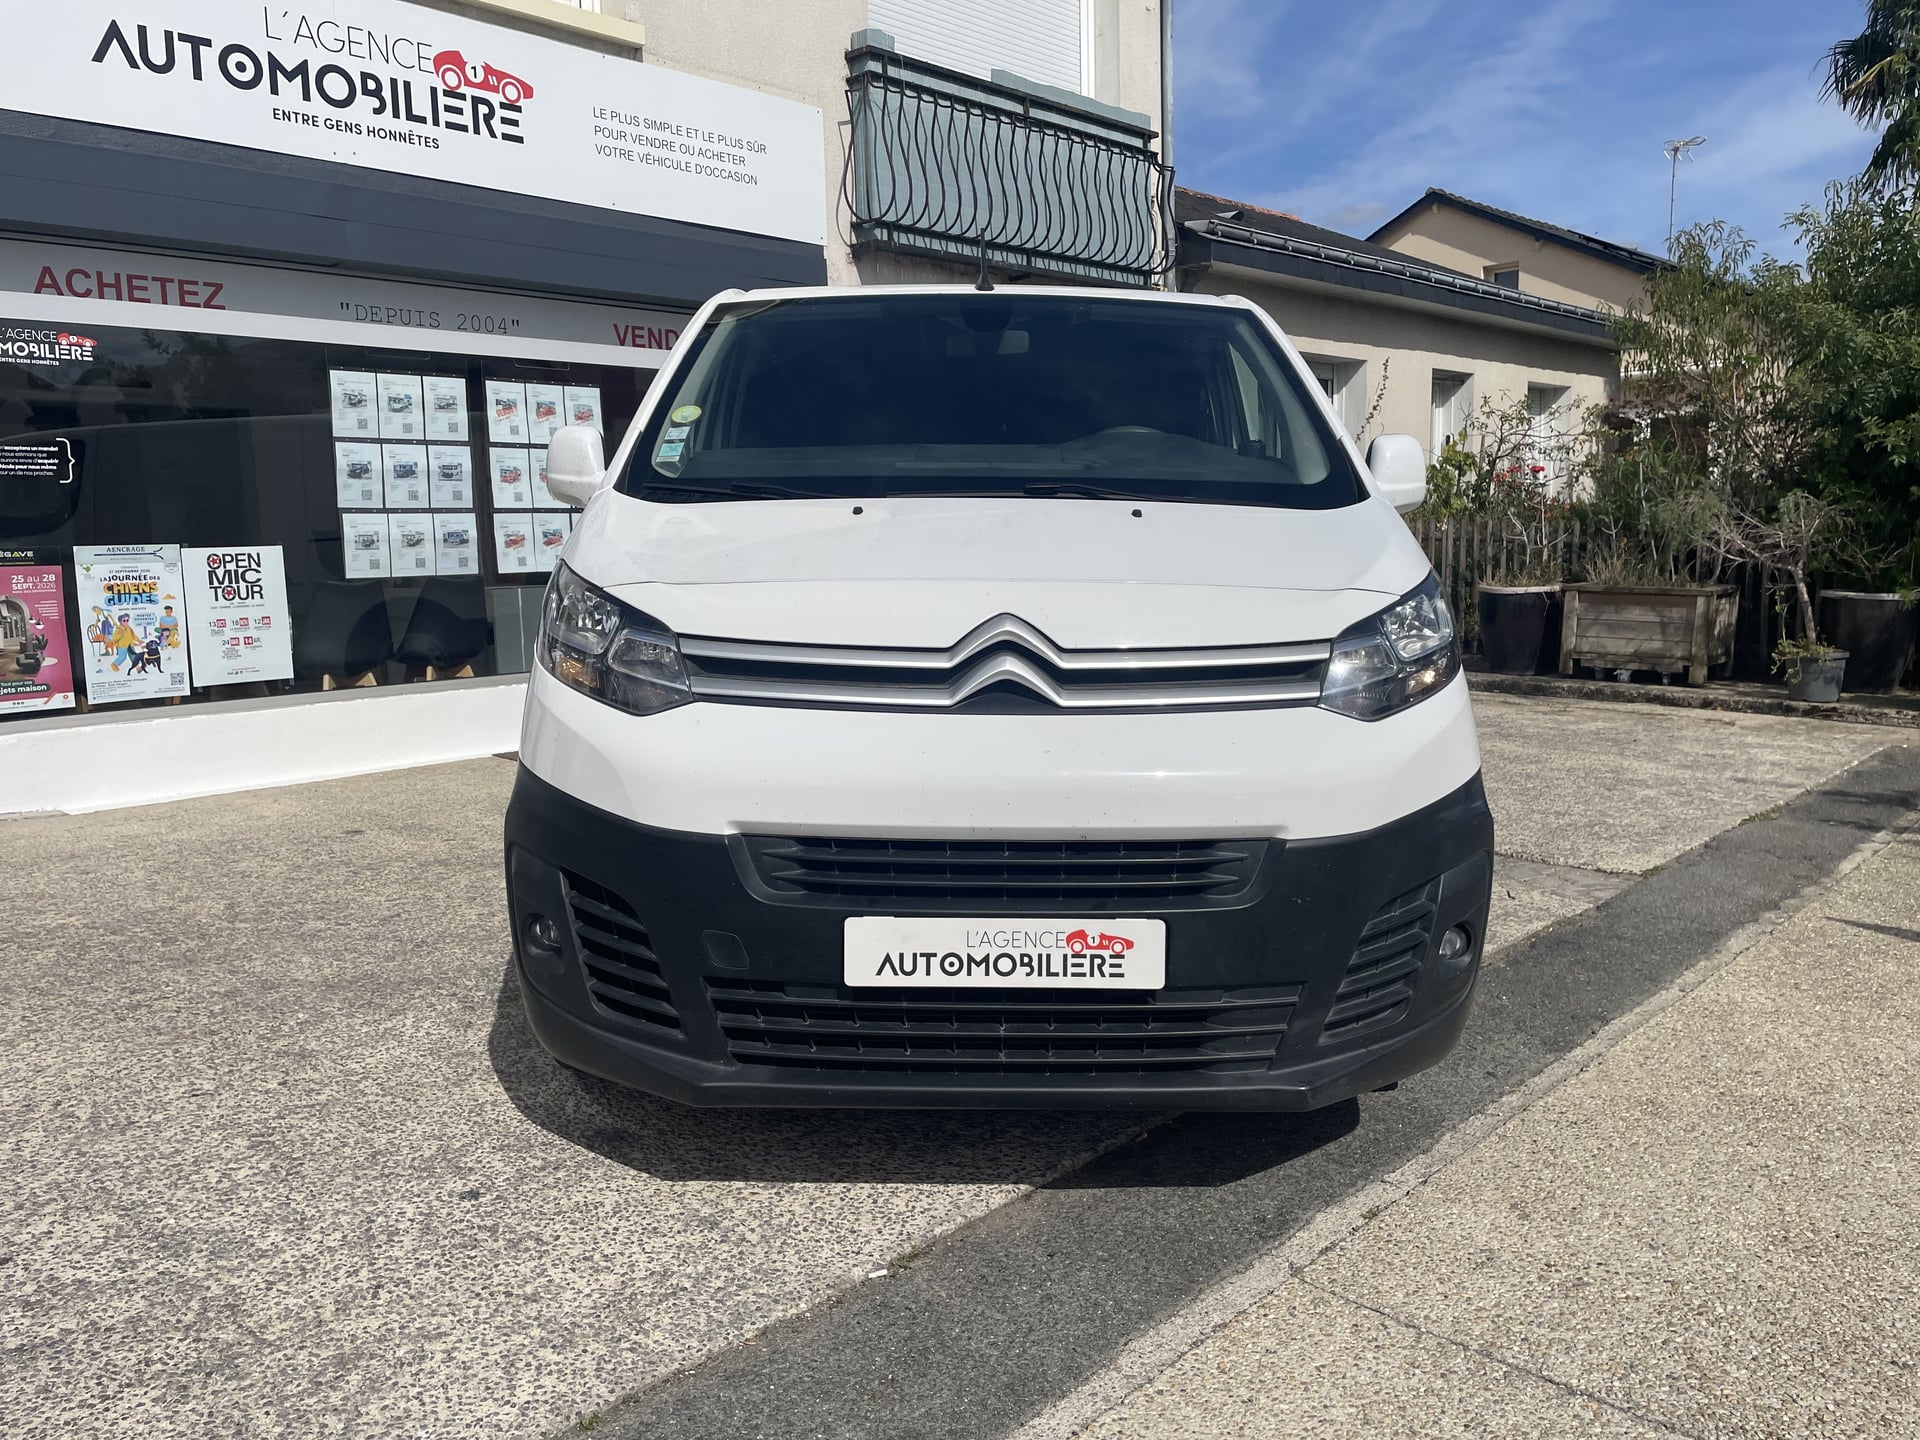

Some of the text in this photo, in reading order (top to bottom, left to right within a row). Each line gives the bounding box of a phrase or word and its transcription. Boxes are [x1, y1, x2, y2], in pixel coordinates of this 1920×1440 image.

[264, 6, 434, 74] L'AGENCE
[272, 107, 440, 149] ENTRE GENS HONNÊTES
[592, 106, 767, 155] LE PLUS SIMPLE ET LE PLUS SÛR
[594, 125, 746, 167] POUR VENDRE OU ACHETER
[595, 143, 758, 186] VOTRE VÉHICULE D'OCCASION
[33, 265, 226, 311] ACHETEZ
[206, 552, 262, 569] OPEN
[11, 574, 25, 583] 25
[42, 573, 56, 582] 28
[108, 573, 149, 582] JOURNÉE
[207, 568, 263, 585] MIC
[103, 581, 158, 594] CHIENS
[208, 584, 264, 602] TOUR
[104, 593, 160, 606] GUIDES
[18, 685, 47, 693] maison
[966, 930, 1067, 949] L'AGENCE
